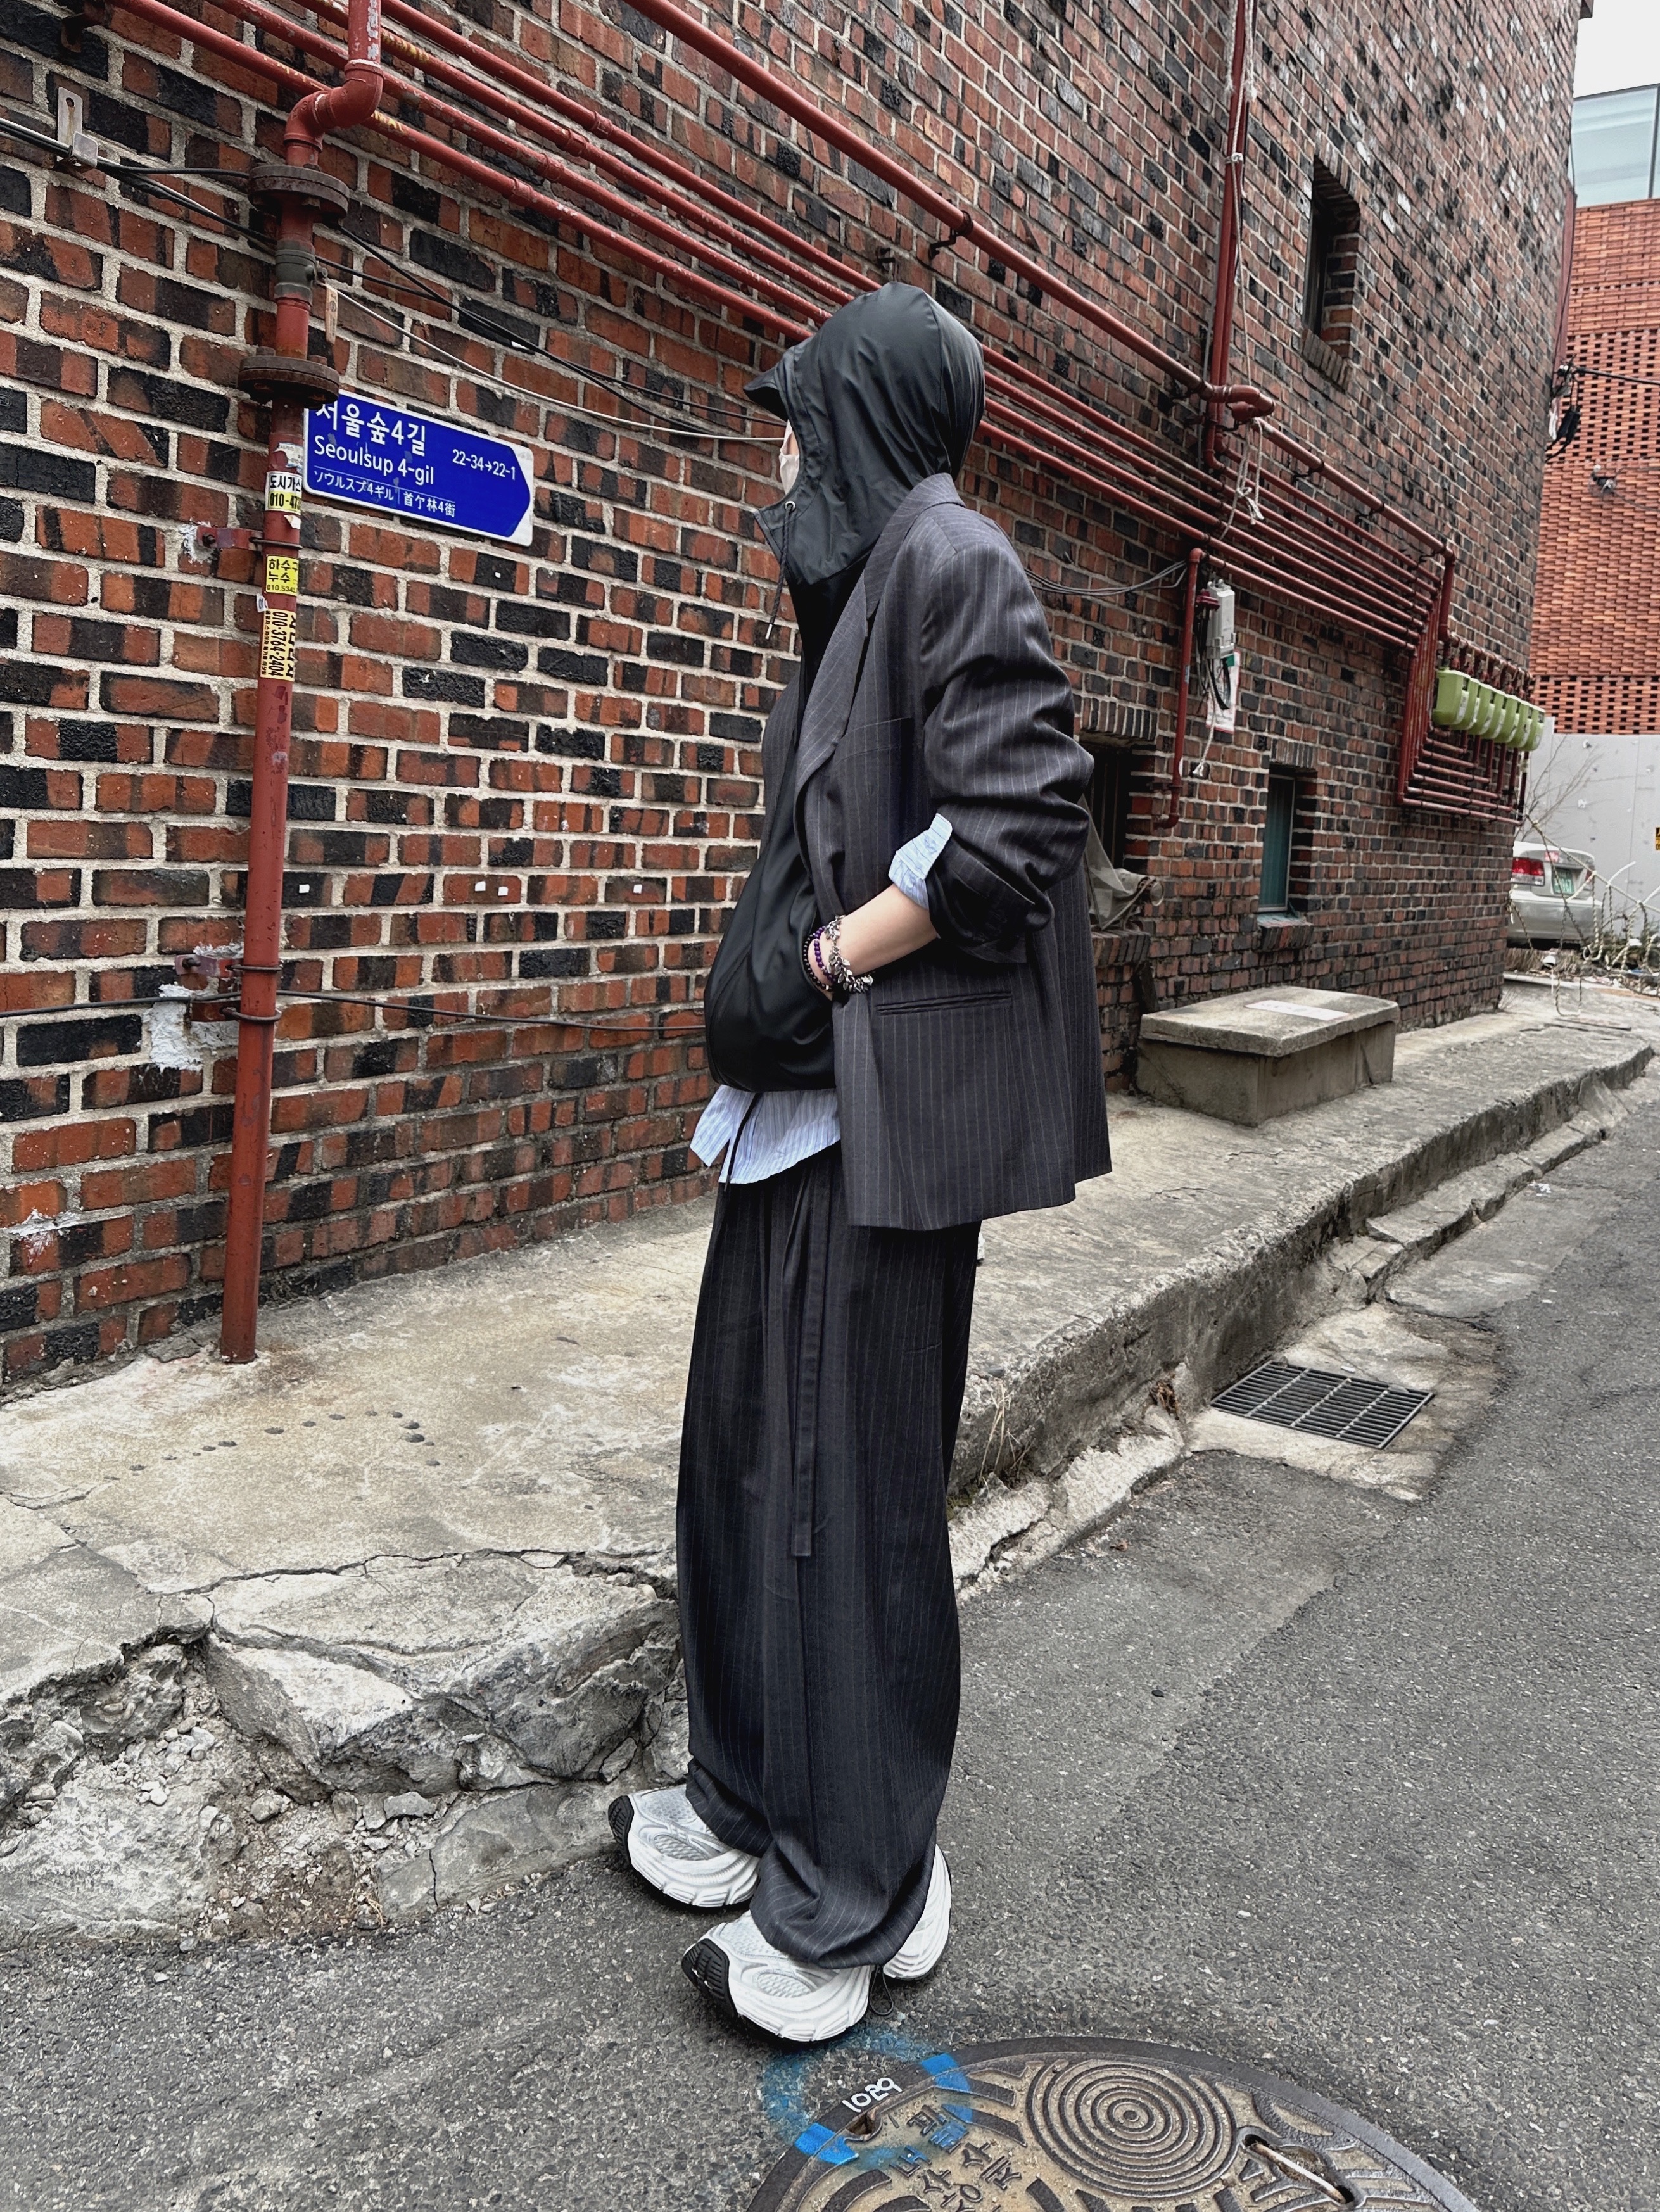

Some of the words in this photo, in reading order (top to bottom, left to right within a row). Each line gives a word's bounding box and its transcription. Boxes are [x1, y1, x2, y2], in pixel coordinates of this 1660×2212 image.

[315, 400, 426, 457] 서울숲4길
[314, 435, 393, 476] Seoulsup
[398, 458, 434, 486] 4-gil
[452, 449, 484, 471] 22-34
[493, 461, 516, 481] 22-1
[270, 475, 301, 492] 도시가스
[269, 571, 290, 583] 누수
[842, 2077, 903, 2113] 1029
